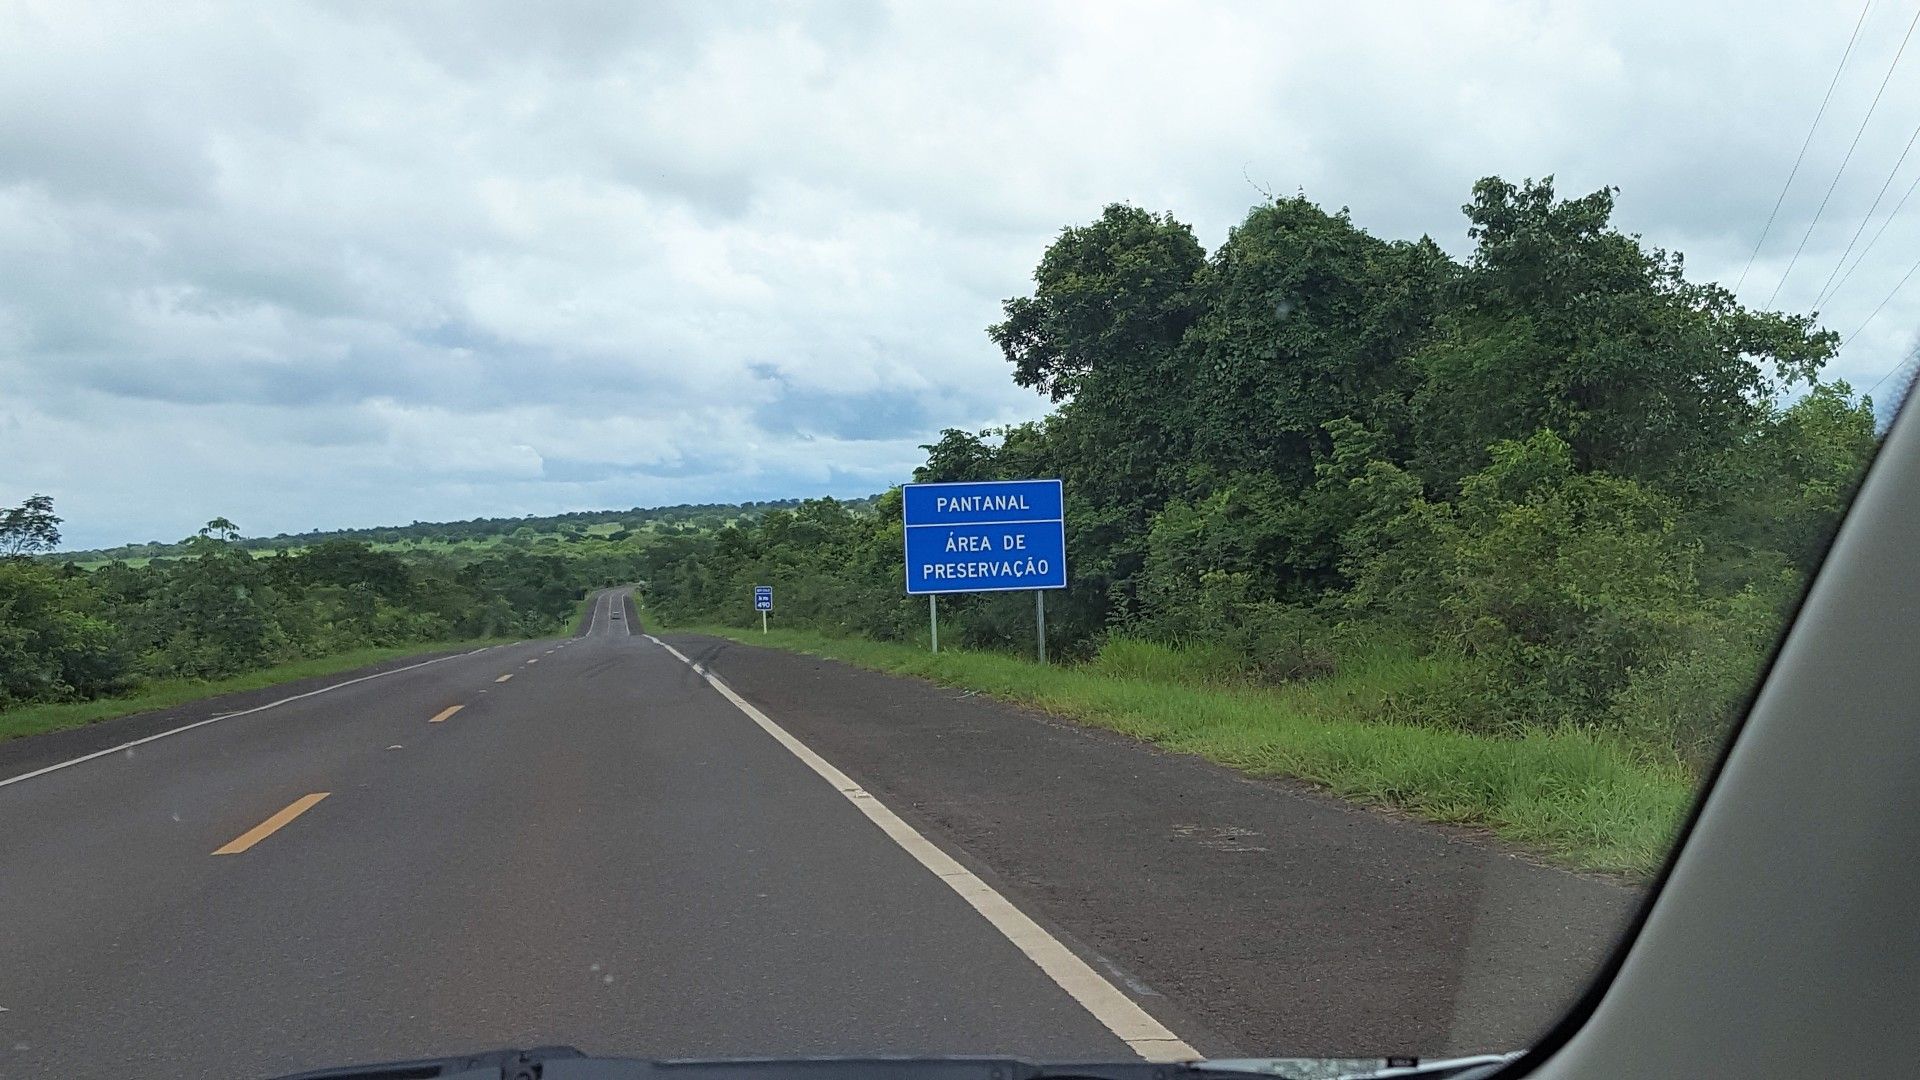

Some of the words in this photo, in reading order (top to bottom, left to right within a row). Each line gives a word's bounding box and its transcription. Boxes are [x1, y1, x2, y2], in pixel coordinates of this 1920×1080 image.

[937, 495, 1030, 513] PANTANAL
[945, 531, 992, 553] ÁREA
[1003, 534, 1027, 551] DE
[923, 557, 1049, 580] PRESERVAÇÃO
